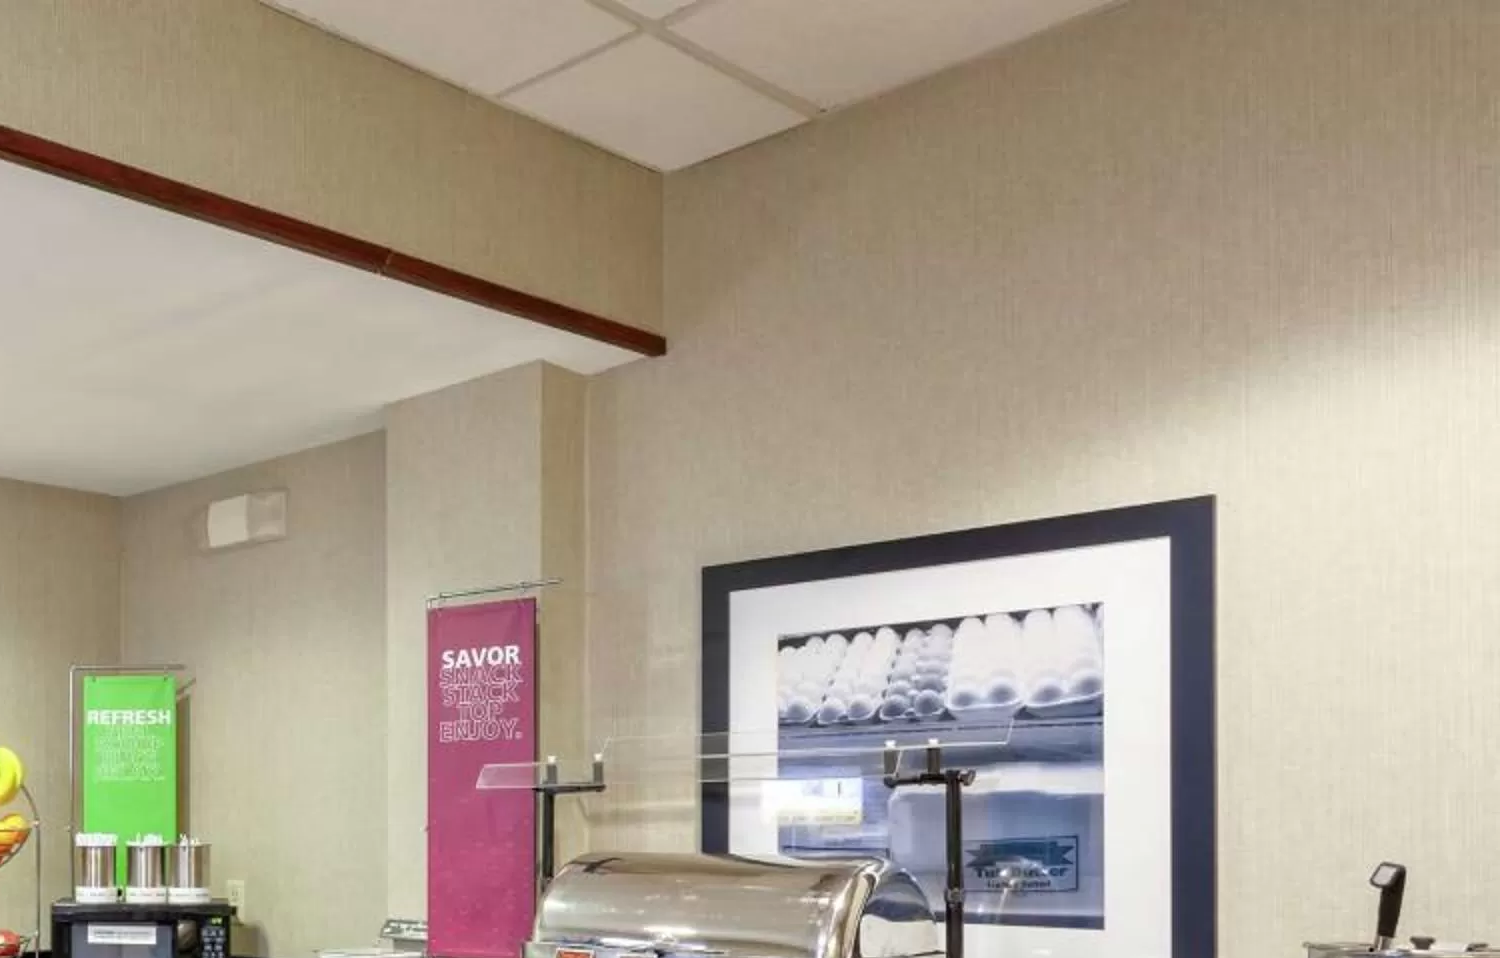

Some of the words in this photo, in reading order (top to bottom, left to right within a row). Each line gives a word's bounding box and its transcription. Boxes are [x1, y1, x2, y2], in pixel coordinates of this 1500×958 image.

[442, 645, 521, 669] SAVOR
[440, 664, 523, 686] SNACK
[440, 681, 520, 706] STACK
[87, 708, 171, 725] REFRESH
[456, 700, 503, 721] TOP
[440, 718, 524, 742] ENJOY.
